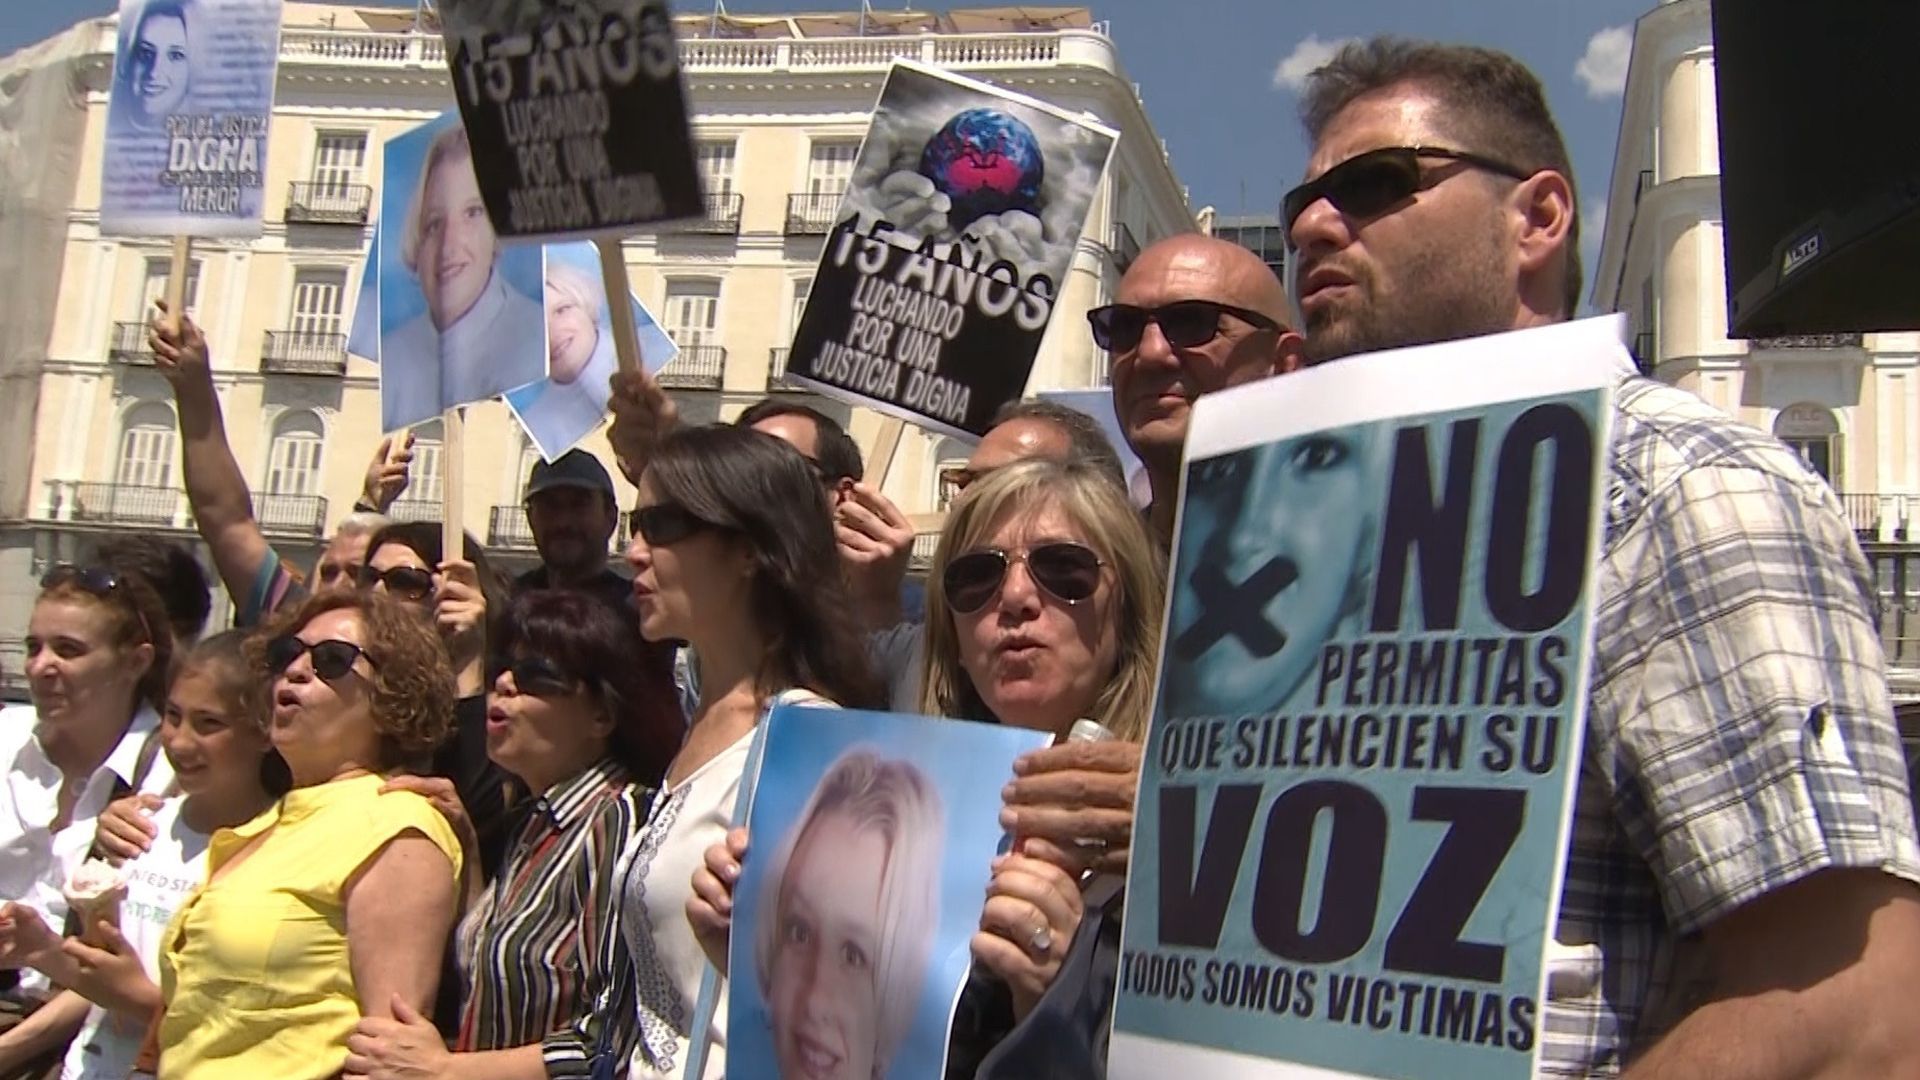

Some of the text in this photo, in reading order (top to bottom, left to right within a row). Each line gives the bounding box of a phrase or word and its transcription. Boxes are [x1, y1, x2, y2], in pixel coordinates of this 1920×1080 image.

[455, 36, 513, 106] 15
[168, 137, 259, 173] DIGNA
[180, 186, 241, 213] MENOR
[834, 212, 1054, 330] 15 AÑOS
[846, 312, 943, 374] POR UNA
[852, 274, 964, 341] LUCHANDO
[810, 340, 971, 424] JUSTICIA DIGNA
[1369, 403, 1593, 633] NO
[1314, 634, 1567, 709] PERMITAS
[1159, 713, 1560, 776] QUE SILENCIEN SU
[1157, 779, 1529, 984] VOZ
[1121, 951, 1536, 1053] TODOS SOMOS VICTIMAS
